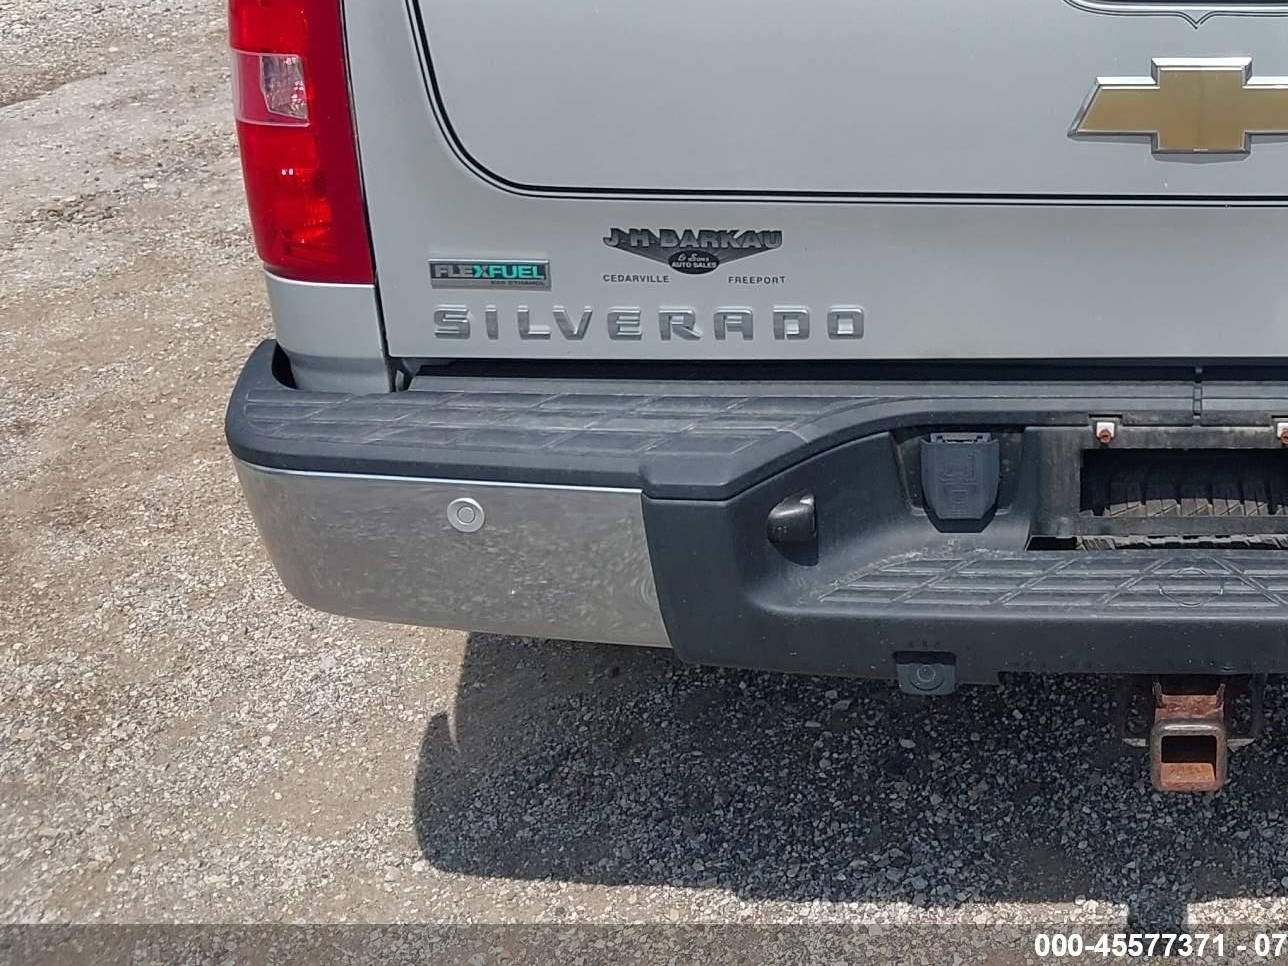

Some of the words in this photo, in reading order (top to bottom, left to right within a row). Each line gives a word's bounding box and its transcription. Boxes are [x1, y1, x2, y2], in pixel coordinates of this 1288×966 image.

[693, 261, 717, 269] SALES
[434, 264, 545, 279] FLEXFUEL
[603, 274, 670, 283] CEDARVILLE
[728, 276, 786, 284] FREEPORT
[433, 306, 867, 341] SILVERADO
